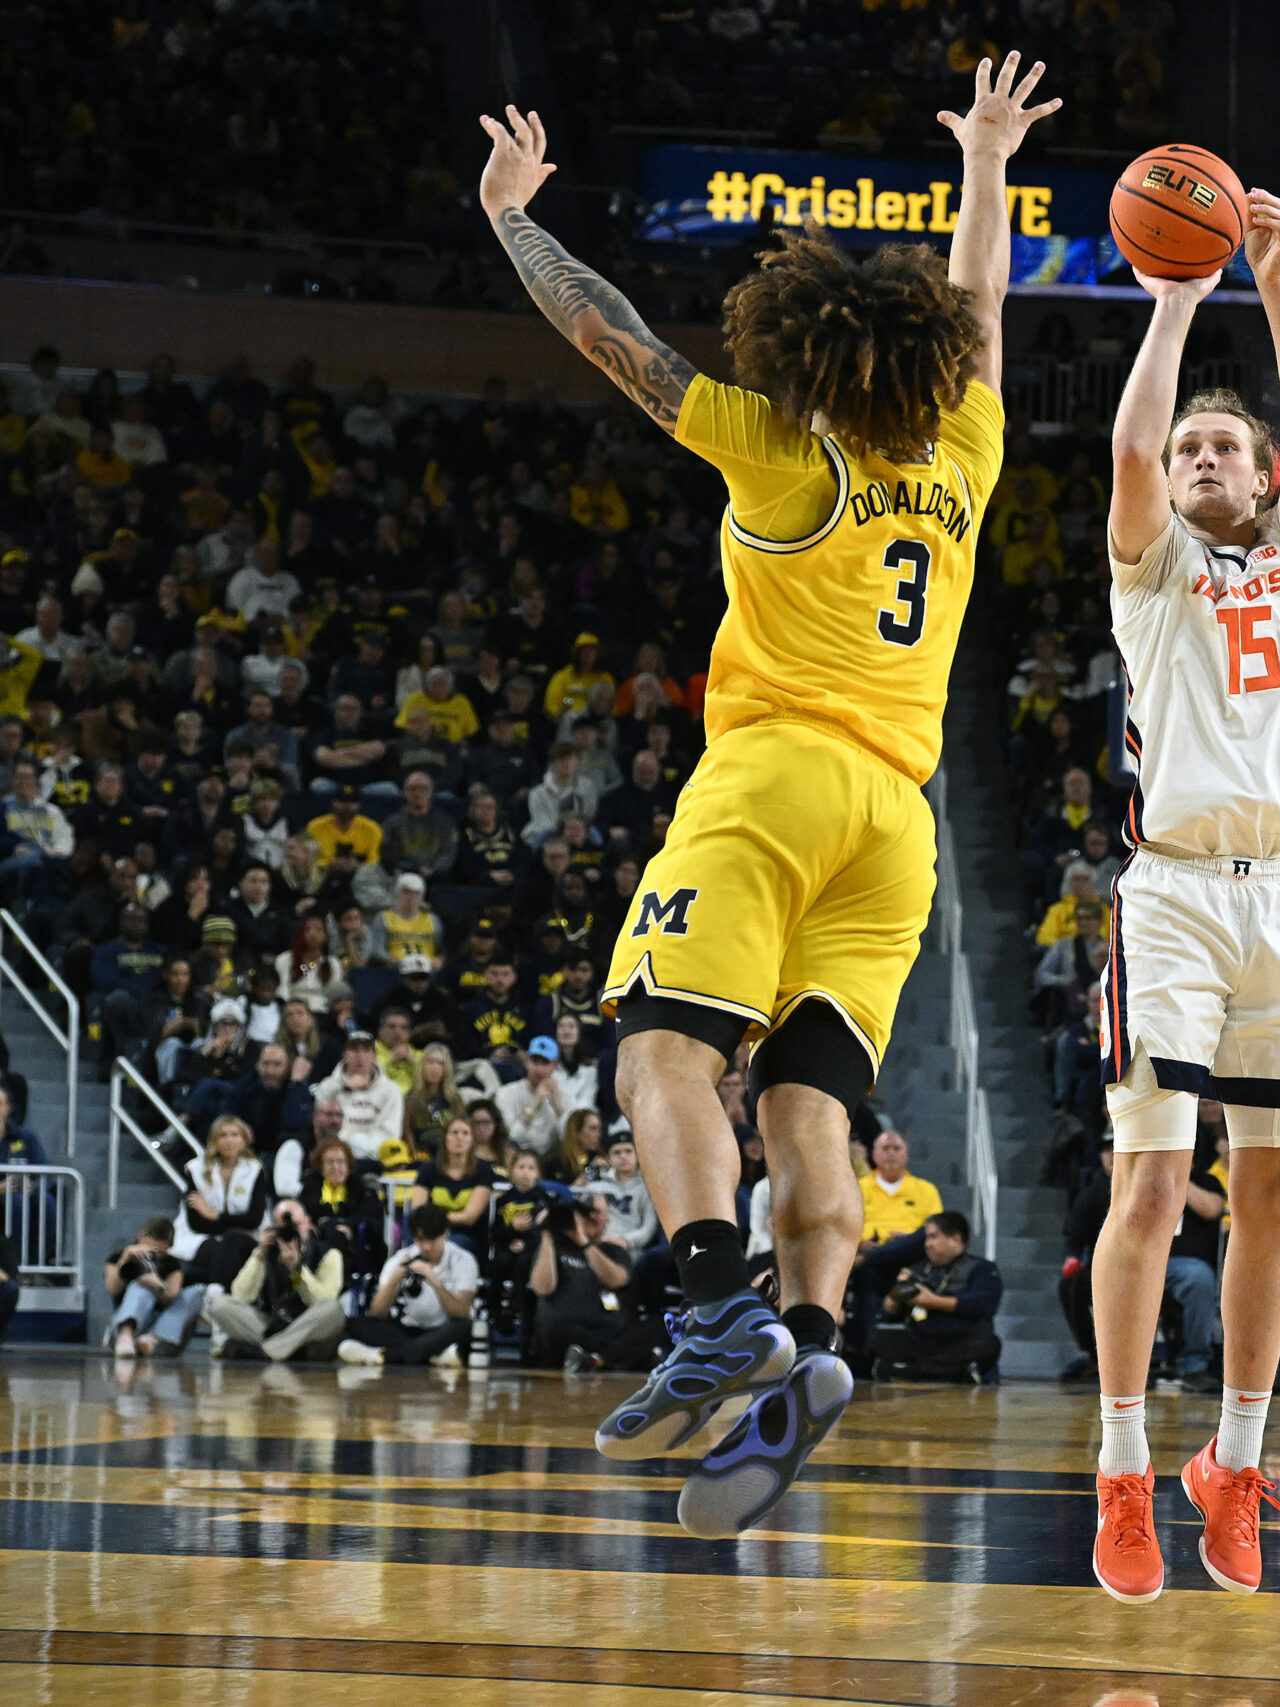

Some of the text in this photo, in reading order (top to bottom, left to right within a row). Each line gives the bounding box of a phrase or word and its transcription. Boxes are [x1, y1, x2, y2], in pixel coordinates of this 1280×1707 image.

[706, 171, 1053, 237] #CrislerLE
[1146, 165, 1218, 211] ELITE
[850, 481, 970, 543] DONALDSON
[876, 538, 931, 648] 3
[631, 888, 699, 938] M
